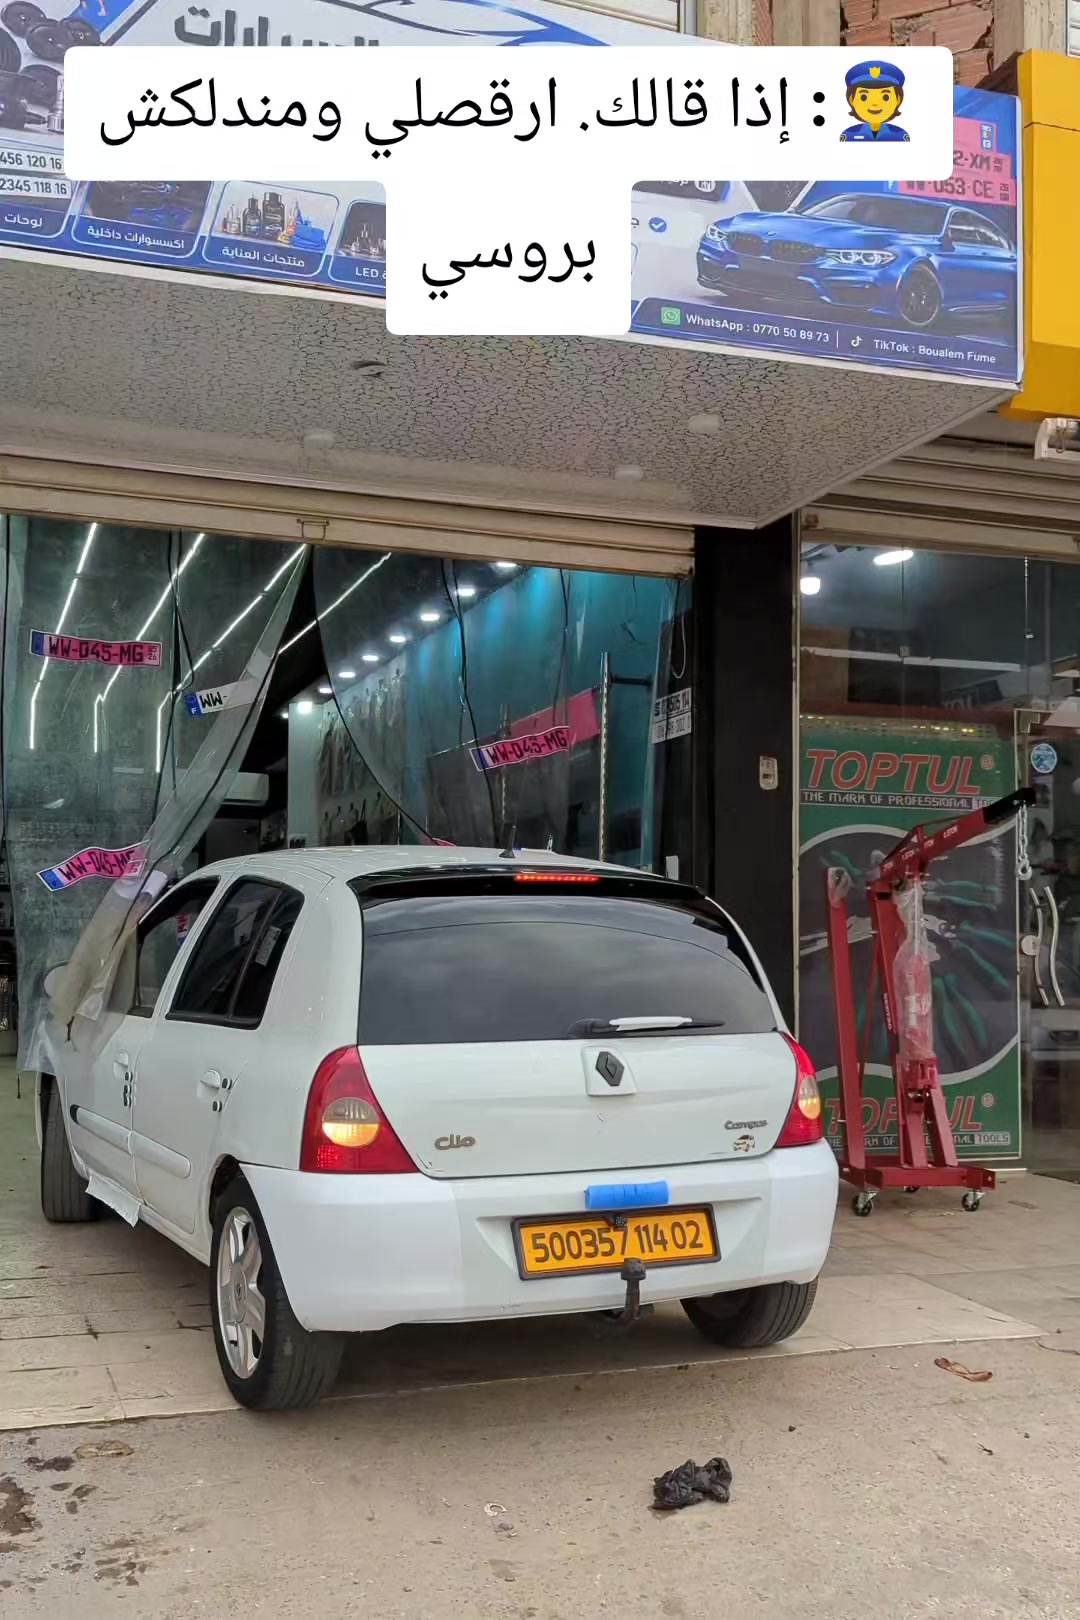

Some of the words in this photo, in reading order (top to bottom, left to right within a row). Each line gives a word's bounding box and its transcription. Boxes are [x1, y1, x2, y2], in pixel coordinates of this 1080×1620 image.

[26, 154, 47, 168] 120
[50, 157, 62, 170] 16
[34, 181, 52, 194] 118
[54, 182, 68, 195] 16
[4, 213, 43, 229] لوحات
[87, 225, 122, 240] داخلية
[124, 232, 185, 249] اكسسوارات
[221, 246, 260, 261] العناية
[263, 253, 305, 268] منتجات
[355, 266, 379, 278] LED
[686, 313, 744, 332] WhatsApp
[752, 323, 780, 336] 0770
[783, 327, 797, 338] 50
[799, 330, 813, 340] 89
[815, 331, 830, 343] 73
[873, 339, 909, 353] TikTok
[918, 345, 965, 360] Boualem
[966, 351, 997, 364] Fume
[806, 749, 980, 795] TOPTUL
[803, 791, 824, 802] THE
[870, 795, 884, 805] OF
[882, 1137, 896, 1147] OF
[976, 1133, 1010, 1144] TOOLS
[532, 1225, 629, 1263] 500357
[634, 1222, 668, 1253] 114
[671, 1219, 704, 1250] 02
